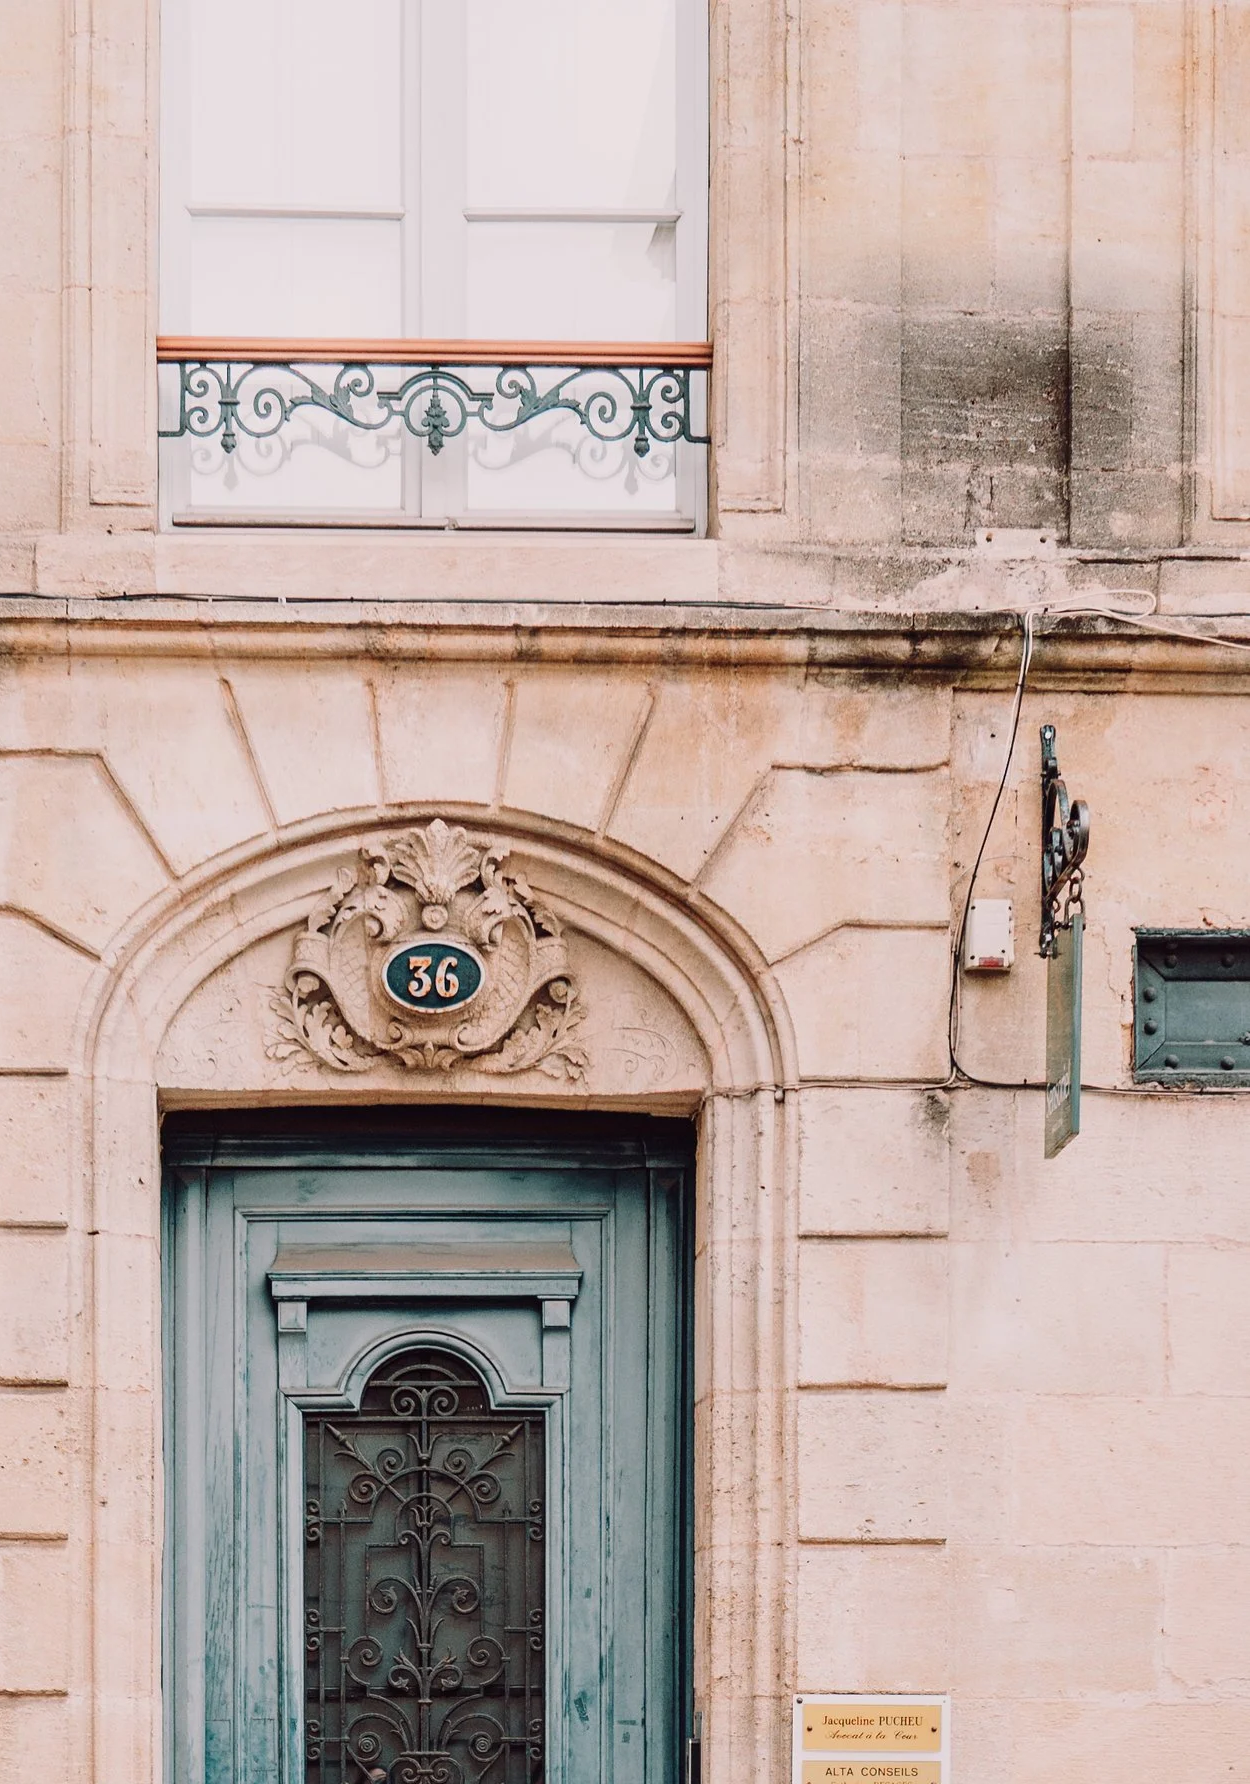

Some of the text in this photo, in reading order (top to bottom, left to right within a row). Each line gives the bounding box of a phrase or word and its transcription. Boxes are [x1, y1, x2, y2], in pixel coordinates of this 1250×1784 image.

[407, 955, 460, 998] 36
[822, 1715, 924, 1728] Jacqueline PUCHEU
[825, 1767, 919, 1777] ALTA CONSEILS
